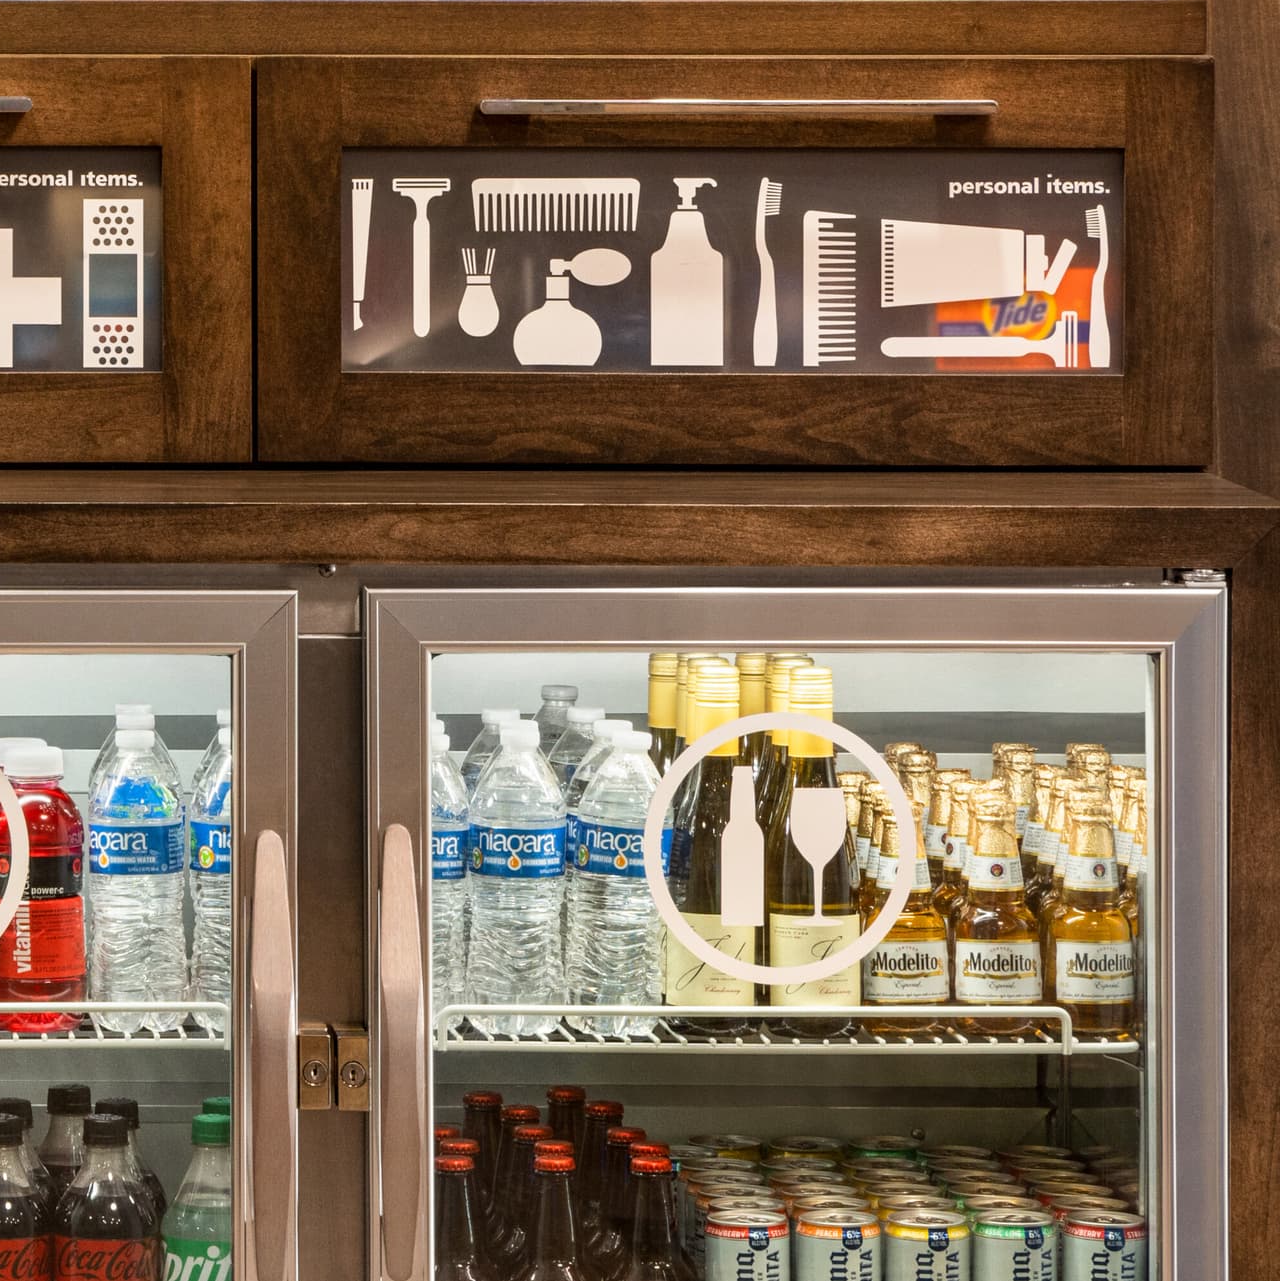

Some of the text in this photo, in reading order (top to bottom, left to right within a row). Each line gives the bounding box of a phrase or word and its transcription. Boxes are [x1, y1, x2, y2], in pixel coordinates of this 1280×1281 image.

[80, 171, 144, 187] items.
[949, 174, 1111, 199] personal items.
[991, 297, 1048, 334] Tide
[479, 827, 557, 855] niagara
[31, 886, 65, 897] power-c
[875, 951, 938, 972] Modelito
[969, 951, 1032, 972] Modelito
[1075, 951, 1133, 972] Modelito
[816, 1228, 838, 1236] PEACH
